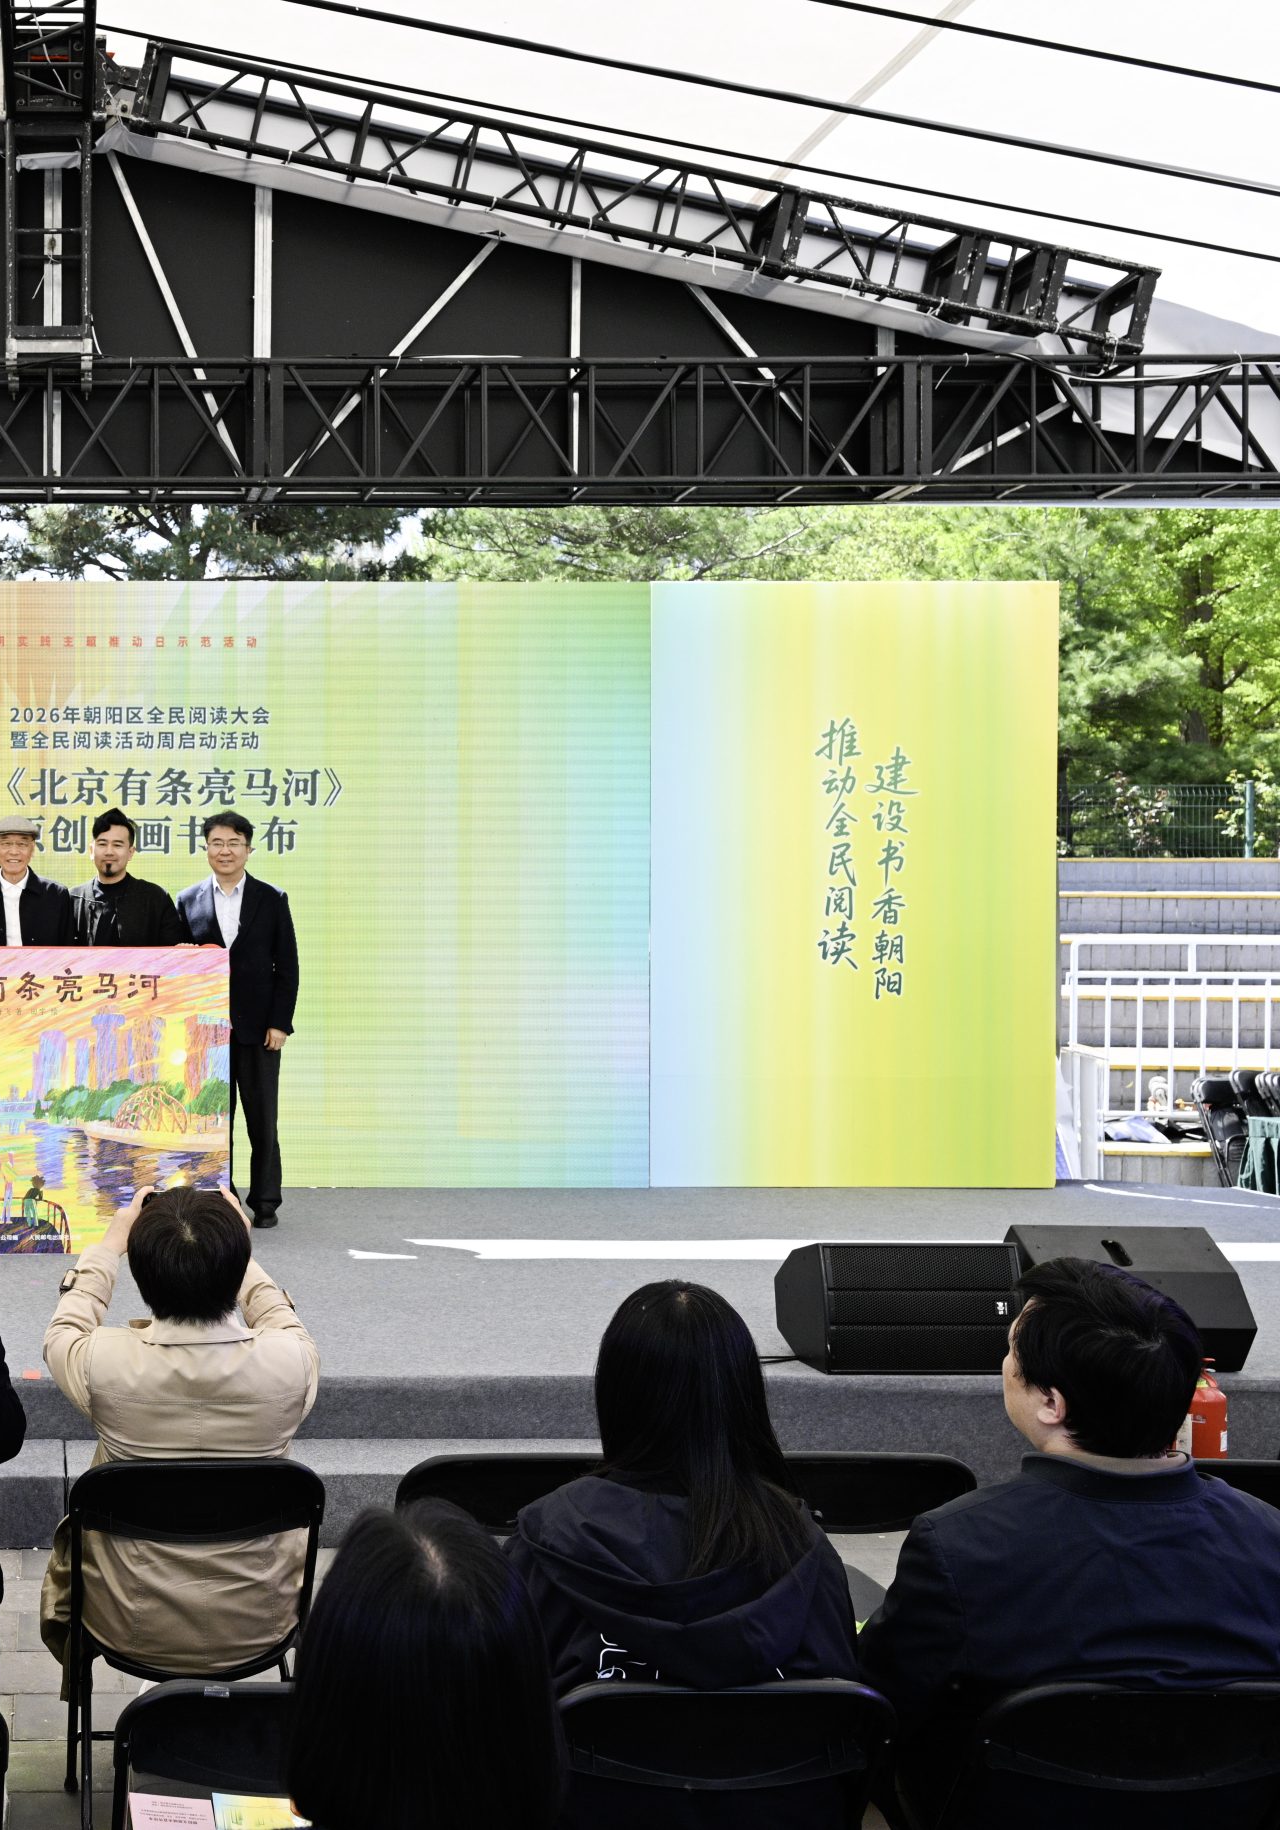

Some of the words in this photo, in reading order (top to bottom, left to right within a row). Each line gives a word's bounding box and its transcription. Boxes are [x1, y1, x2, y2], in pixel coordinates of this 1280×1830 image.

[9, 705, 270, 725] 2026年朝阳区全民阅读大会
[9, 730, 260, 750] 暨全民阅读活动周启动活动
[6, 766, 343, 807] 《北京有条亮马河》
[24, 814, 298, 855] 创画书布
[815, 717, 862, 970] 推动全民阅读
[864, 746, 920, 1000] 建设书香朝阳
